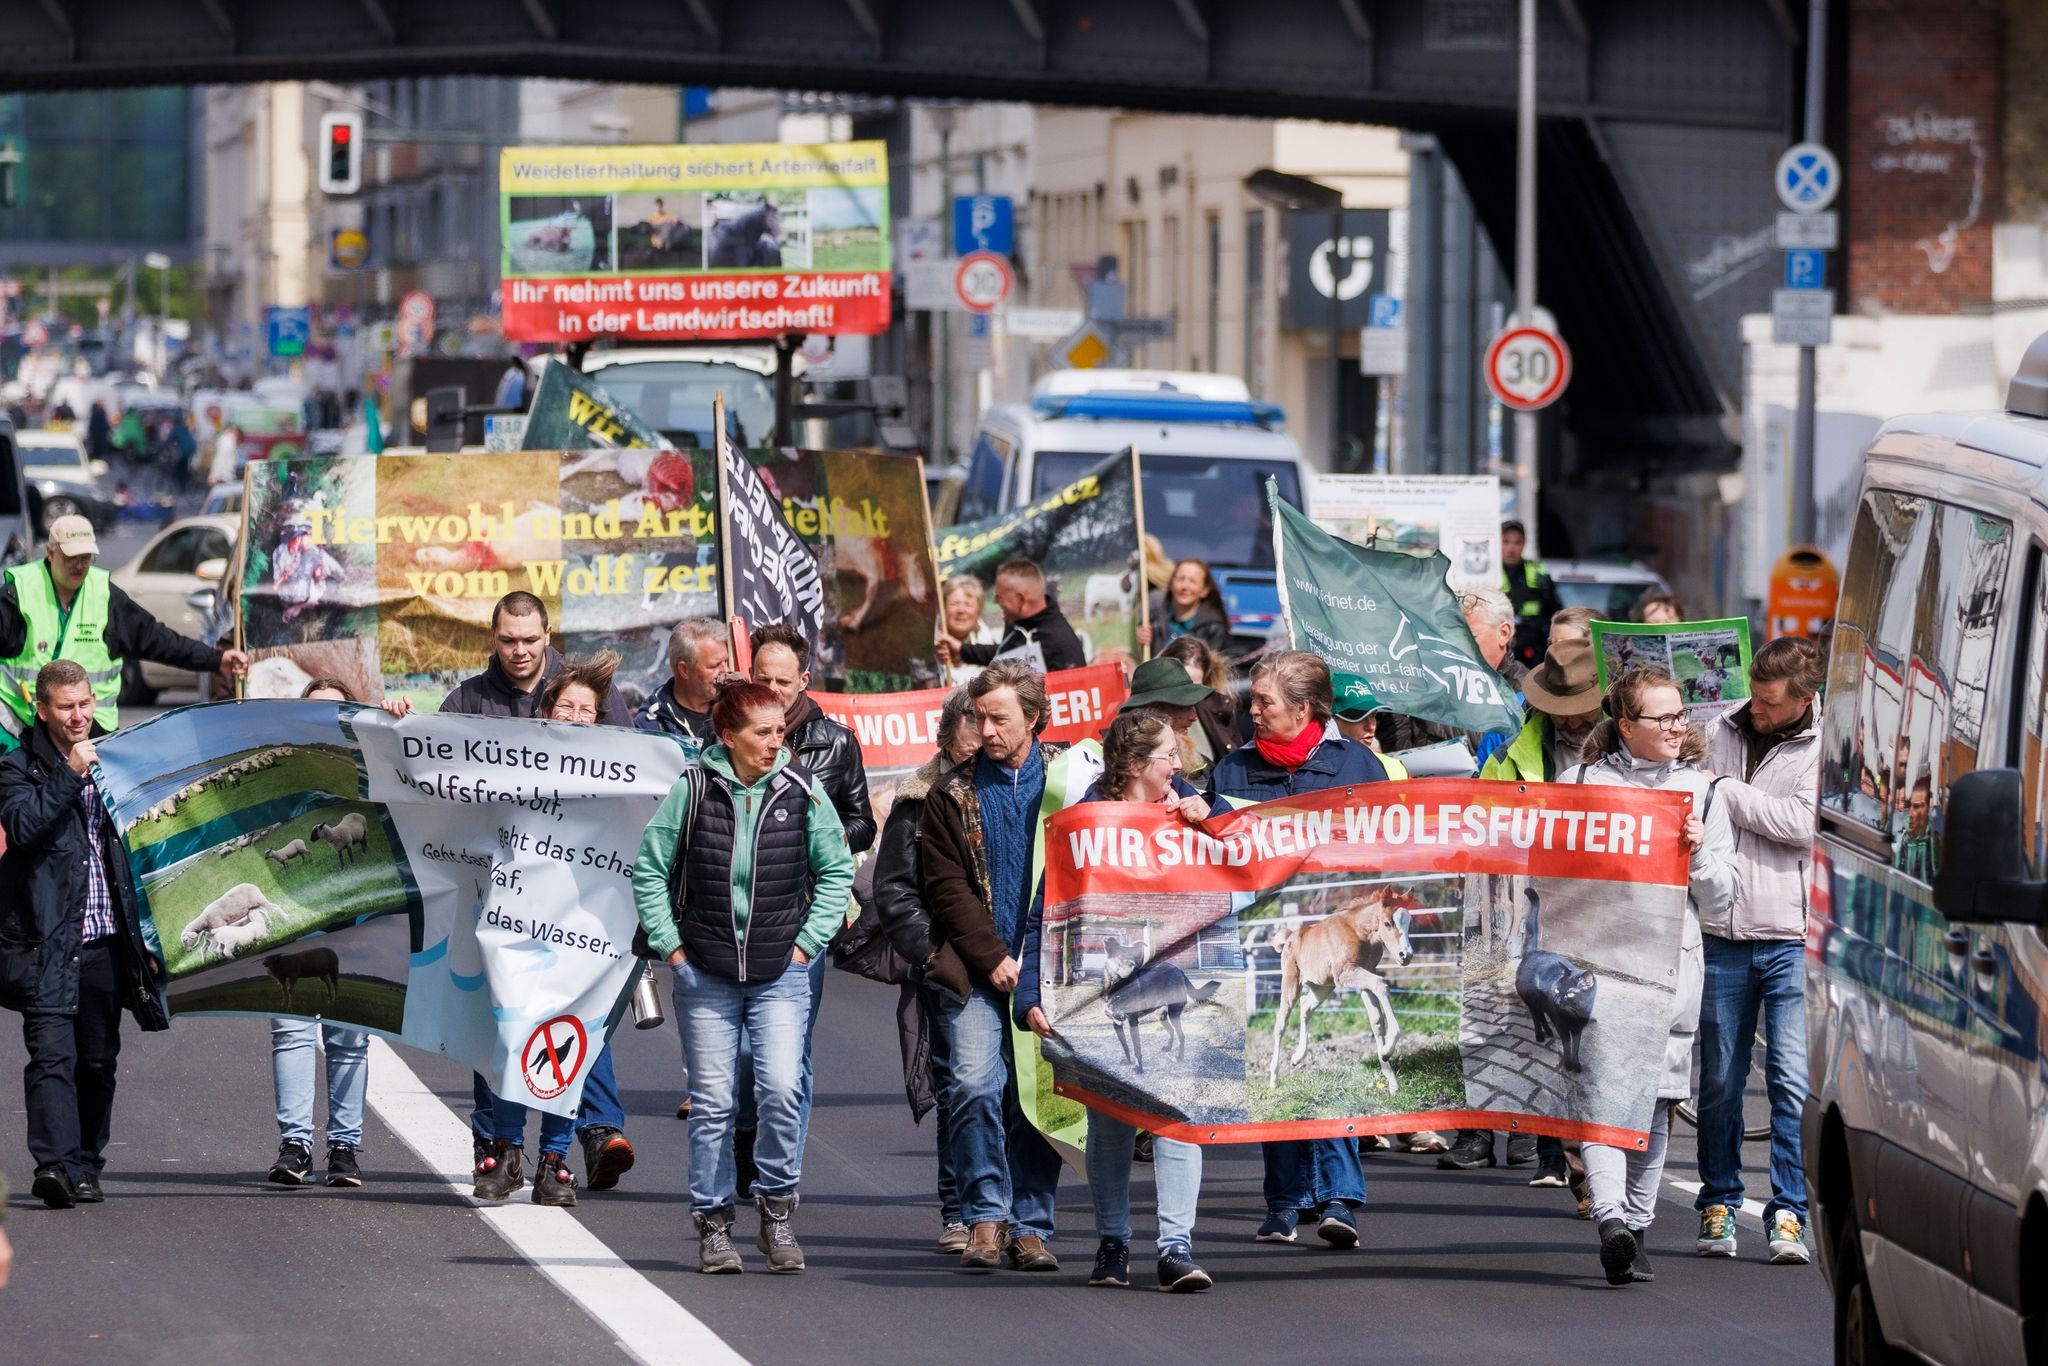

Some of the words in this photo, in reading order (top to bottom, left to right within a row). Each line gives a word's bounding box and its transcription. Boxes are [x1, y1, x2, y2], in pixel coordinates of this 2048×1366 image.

[513, 161, 680, 179] Weidetierhaltung
[687, 159, 754, 177] sichert
[760, 157, 878, 175] Artenvielfalt
[513, 281, 545, 302] Ihr
[554, 278, 633, 302] nehmt
[639, 281, 684, 301] uns
[690, 279, 777, 300] unsere
[783, 274, 880, 298] Zukunft
[559, 309, 582, 332] in
[588, 308, 631, 331] der
[638, 304, 834, 330] Landwirtschaft!
[1505, 350, 1550, 384] 30
[568, 388, 625, 438] Wir
[304, 502, 515, 545] Tierwohl
[533, 498, 623, 539] und
[633, 496, 891, 539] Artielfalt
[406, 568, 510, 599] vom
[522, 553, 636, 597] Wolf
[642, 563, 716, 594] zer
[1355, 641, 1378, 655] der
[1364, 661, 1391, 675] und
[403, 736, 453, 760] Die
[464, 739, 549, 770] Küste
[560, 753, 637, 783] muss
[498, 825, 529, 851] geht
[535, 834, 576, 863] das
[581, 846, 634, 878] Scha
[1069, 826, 1148, 870] WIR
[1156, 826, 1252, 868] SIND
[1252, 809, 1333, 863] KEIN
[1344, 802, 1653, 855] WOLFSFUTTER!
[461, 847, 488, 869] das
[487, 906, 523, 934] das
[532, 919, 622, 960] Wasser...
